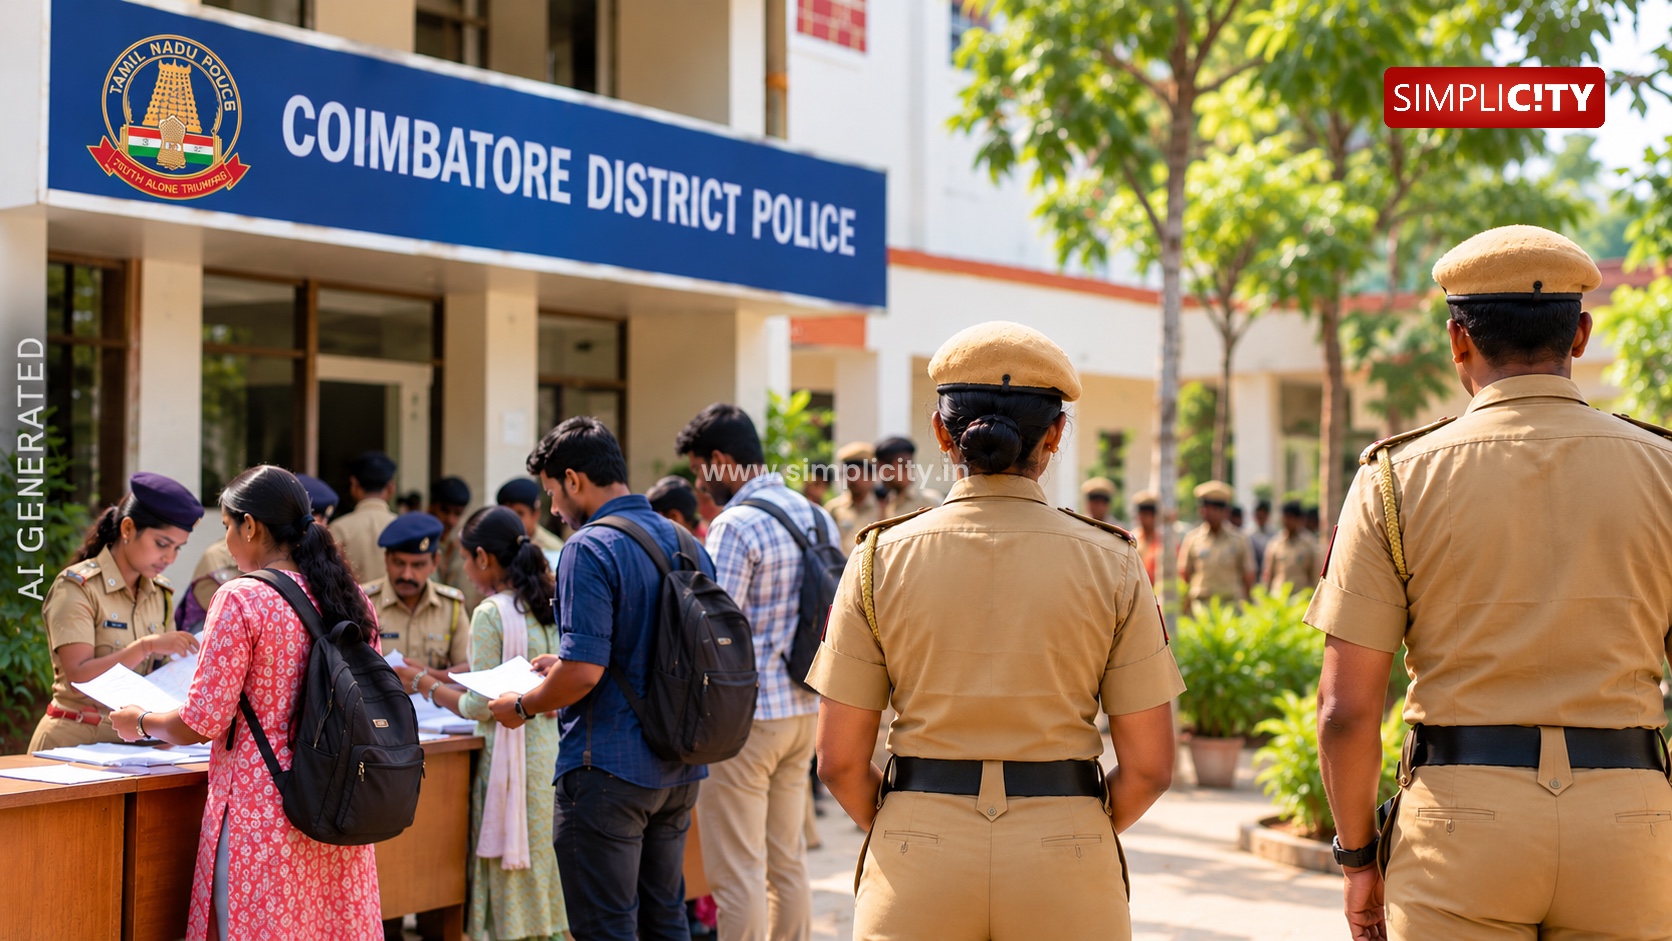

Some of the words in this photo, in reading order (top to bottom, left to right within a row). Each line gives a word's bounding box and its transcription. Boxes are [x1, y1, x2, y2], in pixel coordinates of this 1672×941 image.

[109, 51, 146, 94] TAMIL
[149, 40, 198, 60] NADU
[145, 178, 179, 194] ALONE
[282, 94, 571, 205] COIMBATORE
[587, 153, 742, 235] DISTRICT
[752, 188, 856, 257] POLICE
